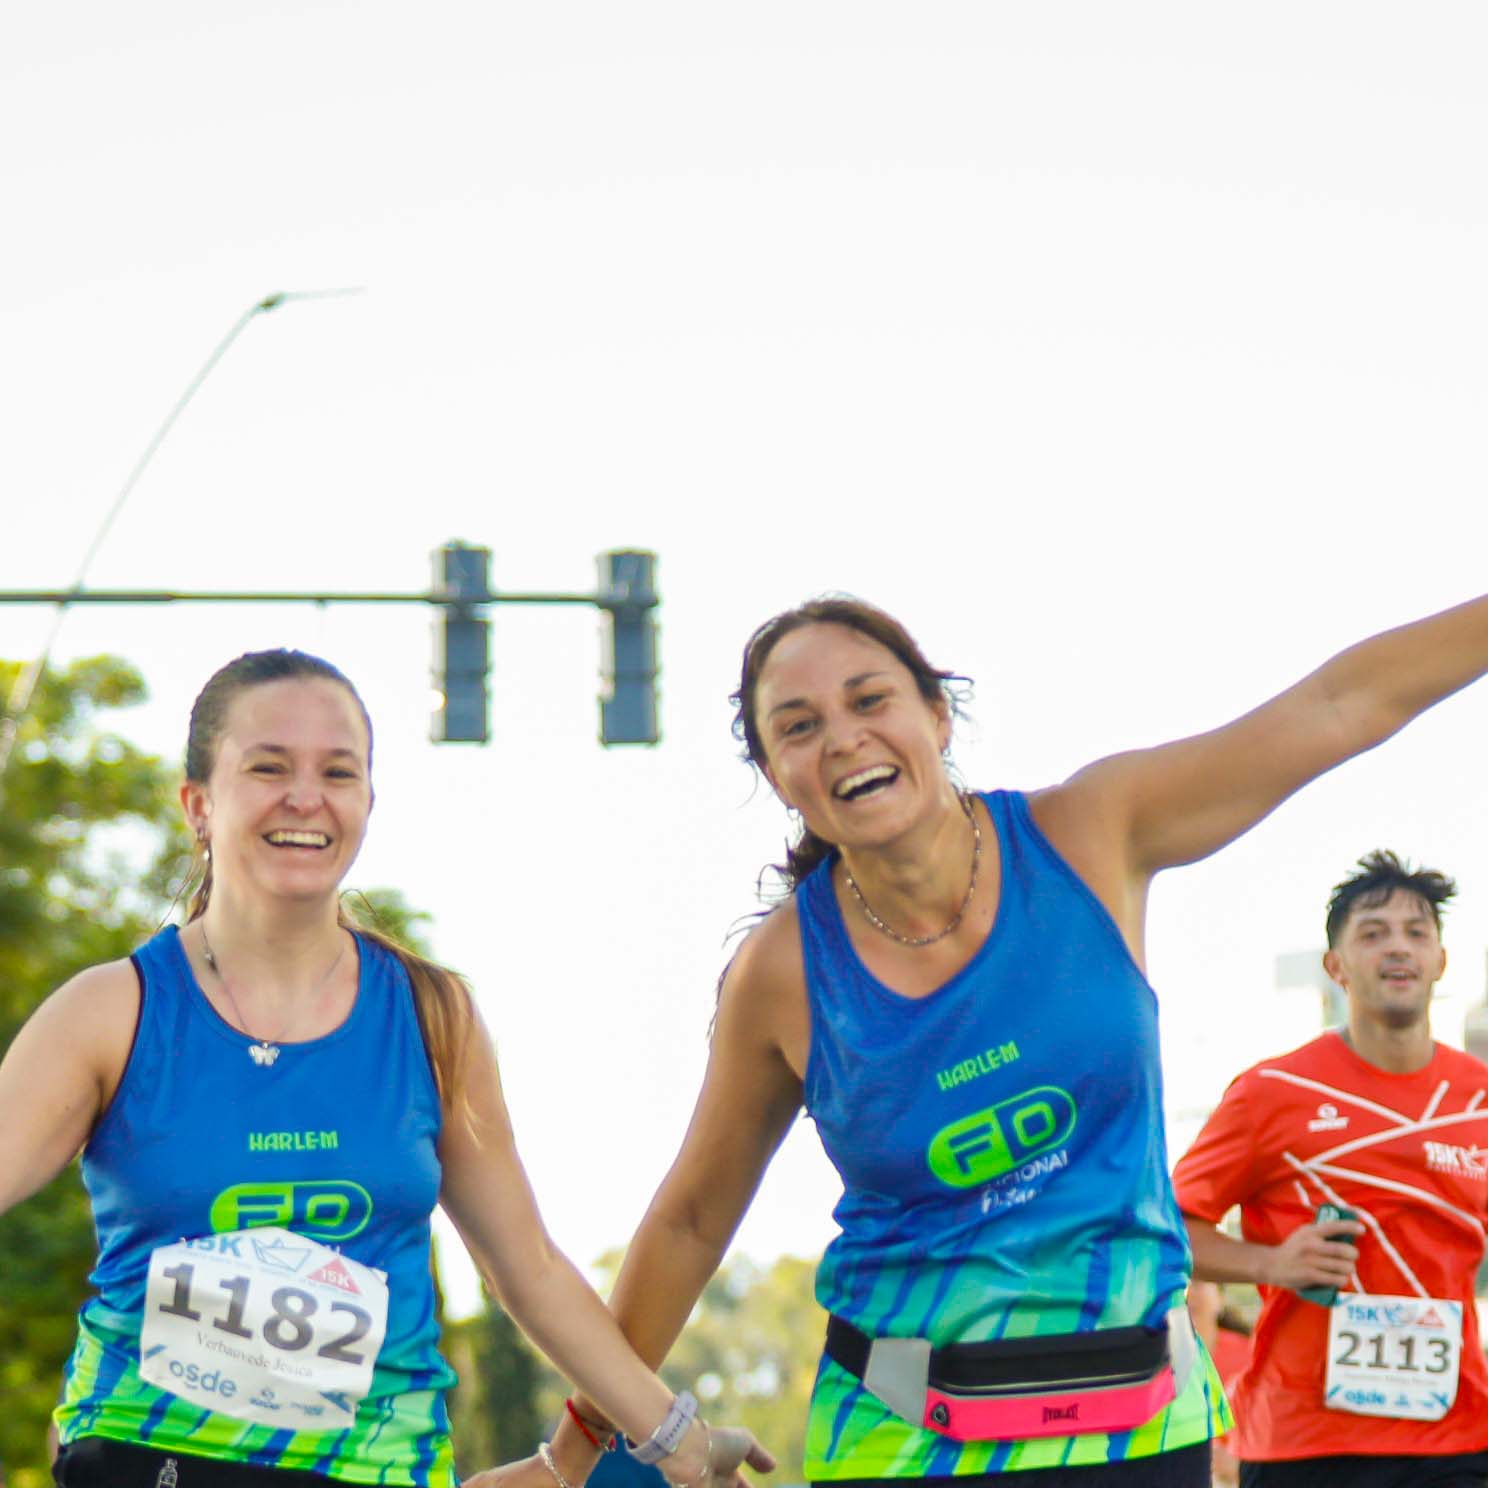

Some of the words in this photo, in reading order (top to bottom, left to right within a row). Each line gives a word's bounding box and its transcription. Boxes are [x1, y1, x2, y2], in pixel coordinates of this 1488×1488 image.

[936, 1040, 1021, 1091] HARLEM
[248, 1130, 339, 1151] HARLEM
[319, 1267, 351, 1289] 15K
[159, 1262, 373, 1366] 1182
[1335, 1330, 1452, 1374] 2113
[169, 1359, 237, 1397] osde
